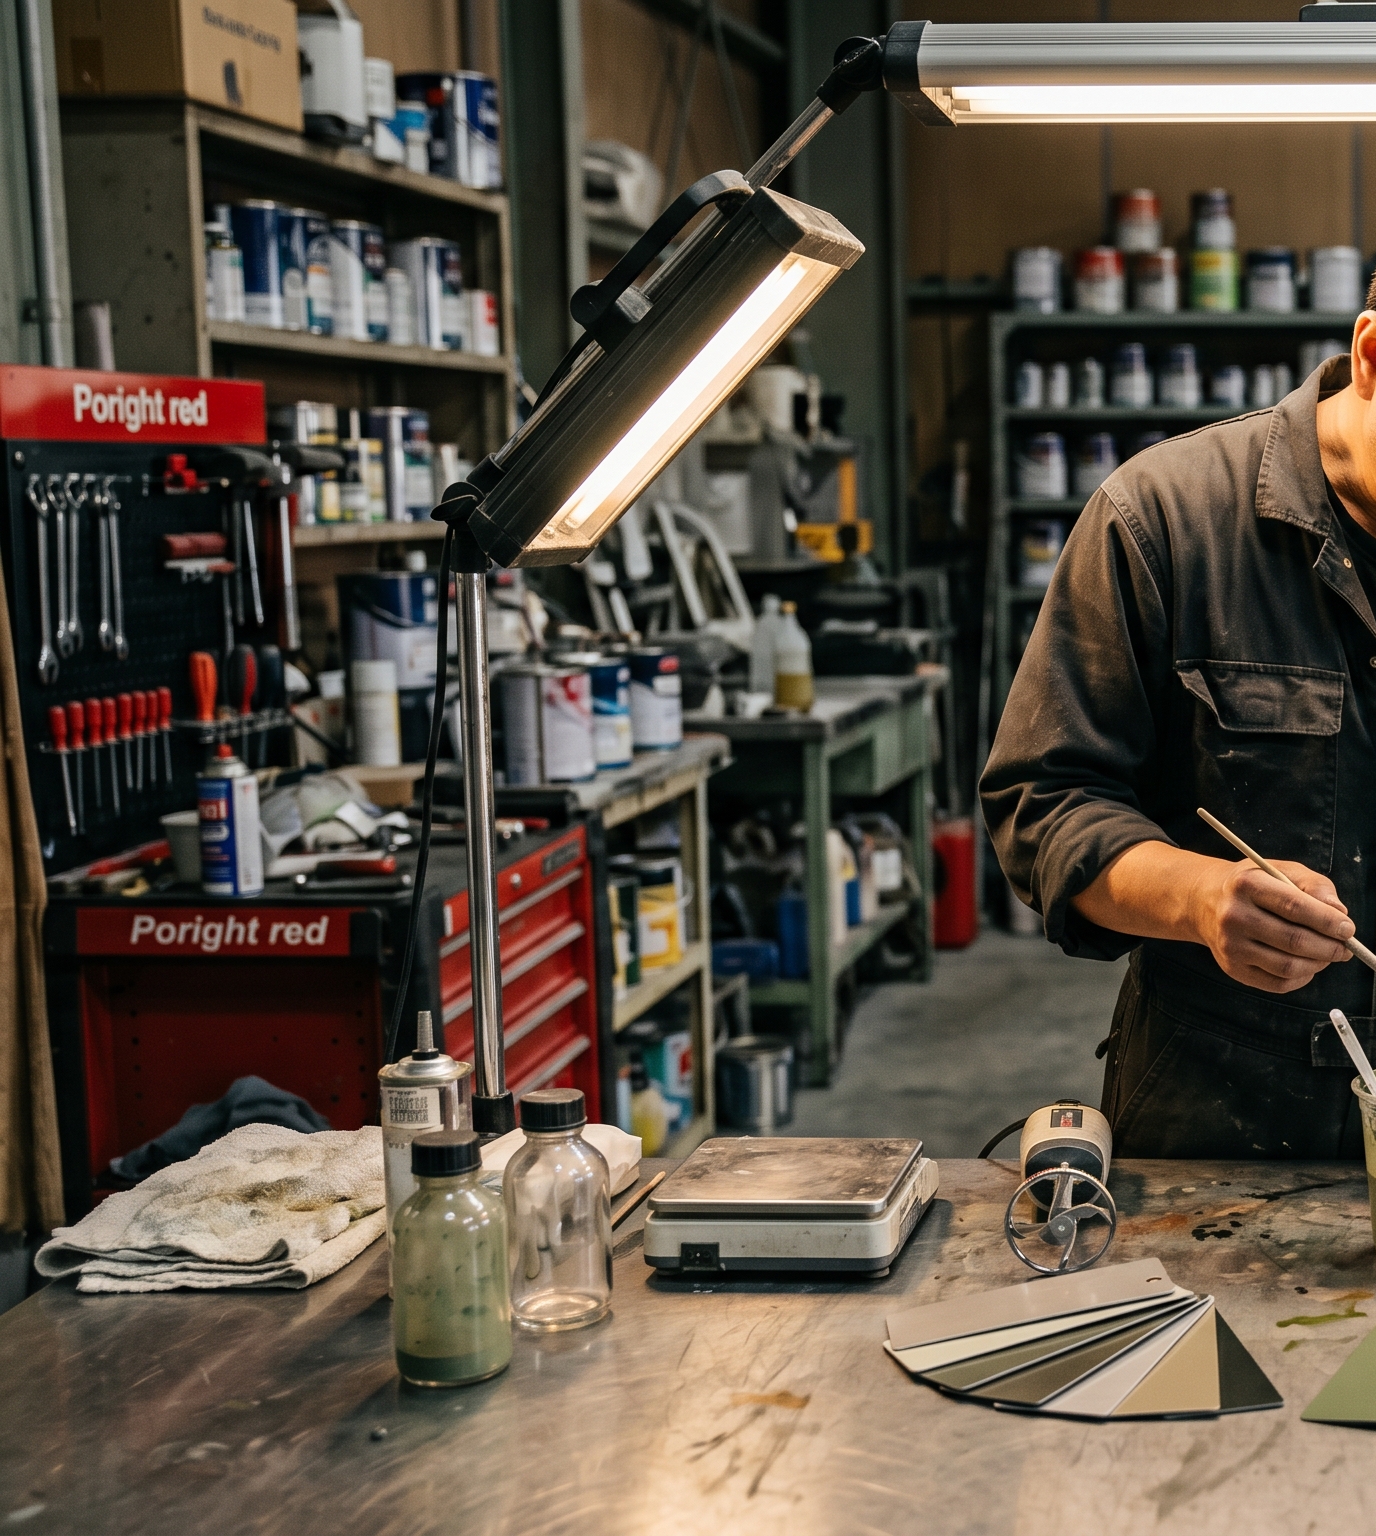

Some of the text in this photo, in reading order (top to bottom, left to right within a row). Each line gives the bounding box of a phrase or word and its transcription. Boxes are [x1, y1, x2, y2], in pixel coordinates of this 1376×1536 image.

[73, 382, 208, 433] Poright red
[130, 914, 329, 952] Poright red
